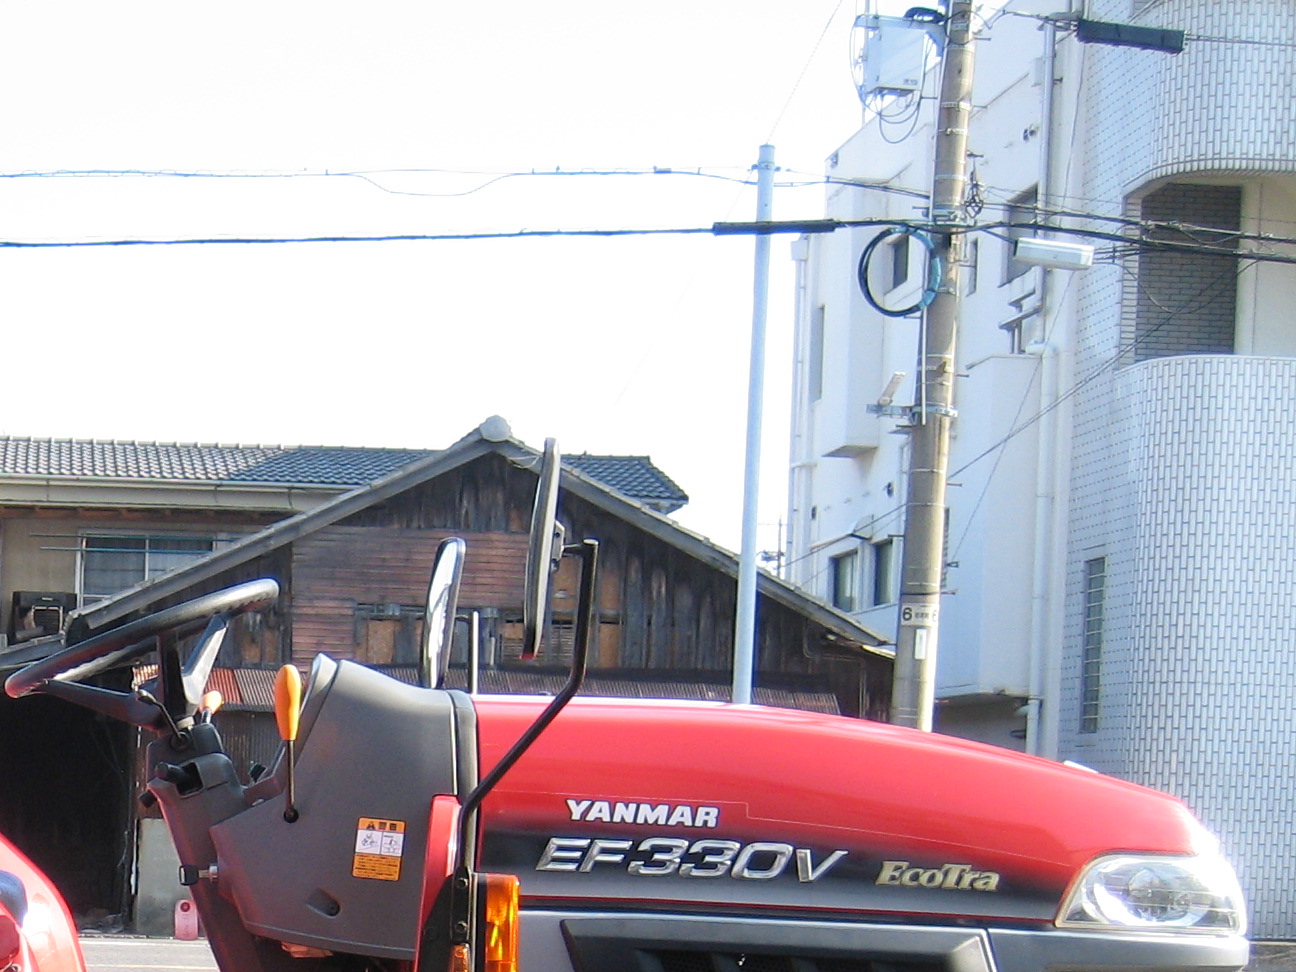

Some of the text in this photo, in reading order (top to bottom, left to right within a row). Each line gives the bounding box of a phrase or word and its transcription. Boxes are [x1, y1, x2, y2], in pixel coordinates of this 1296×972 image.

[902, 606, 913, 621] 6
[565, 799, 719, 828] YANMAR
[535, 836, 849, 883] EF330V
[875, 860, 1001, 892] EcoTra
